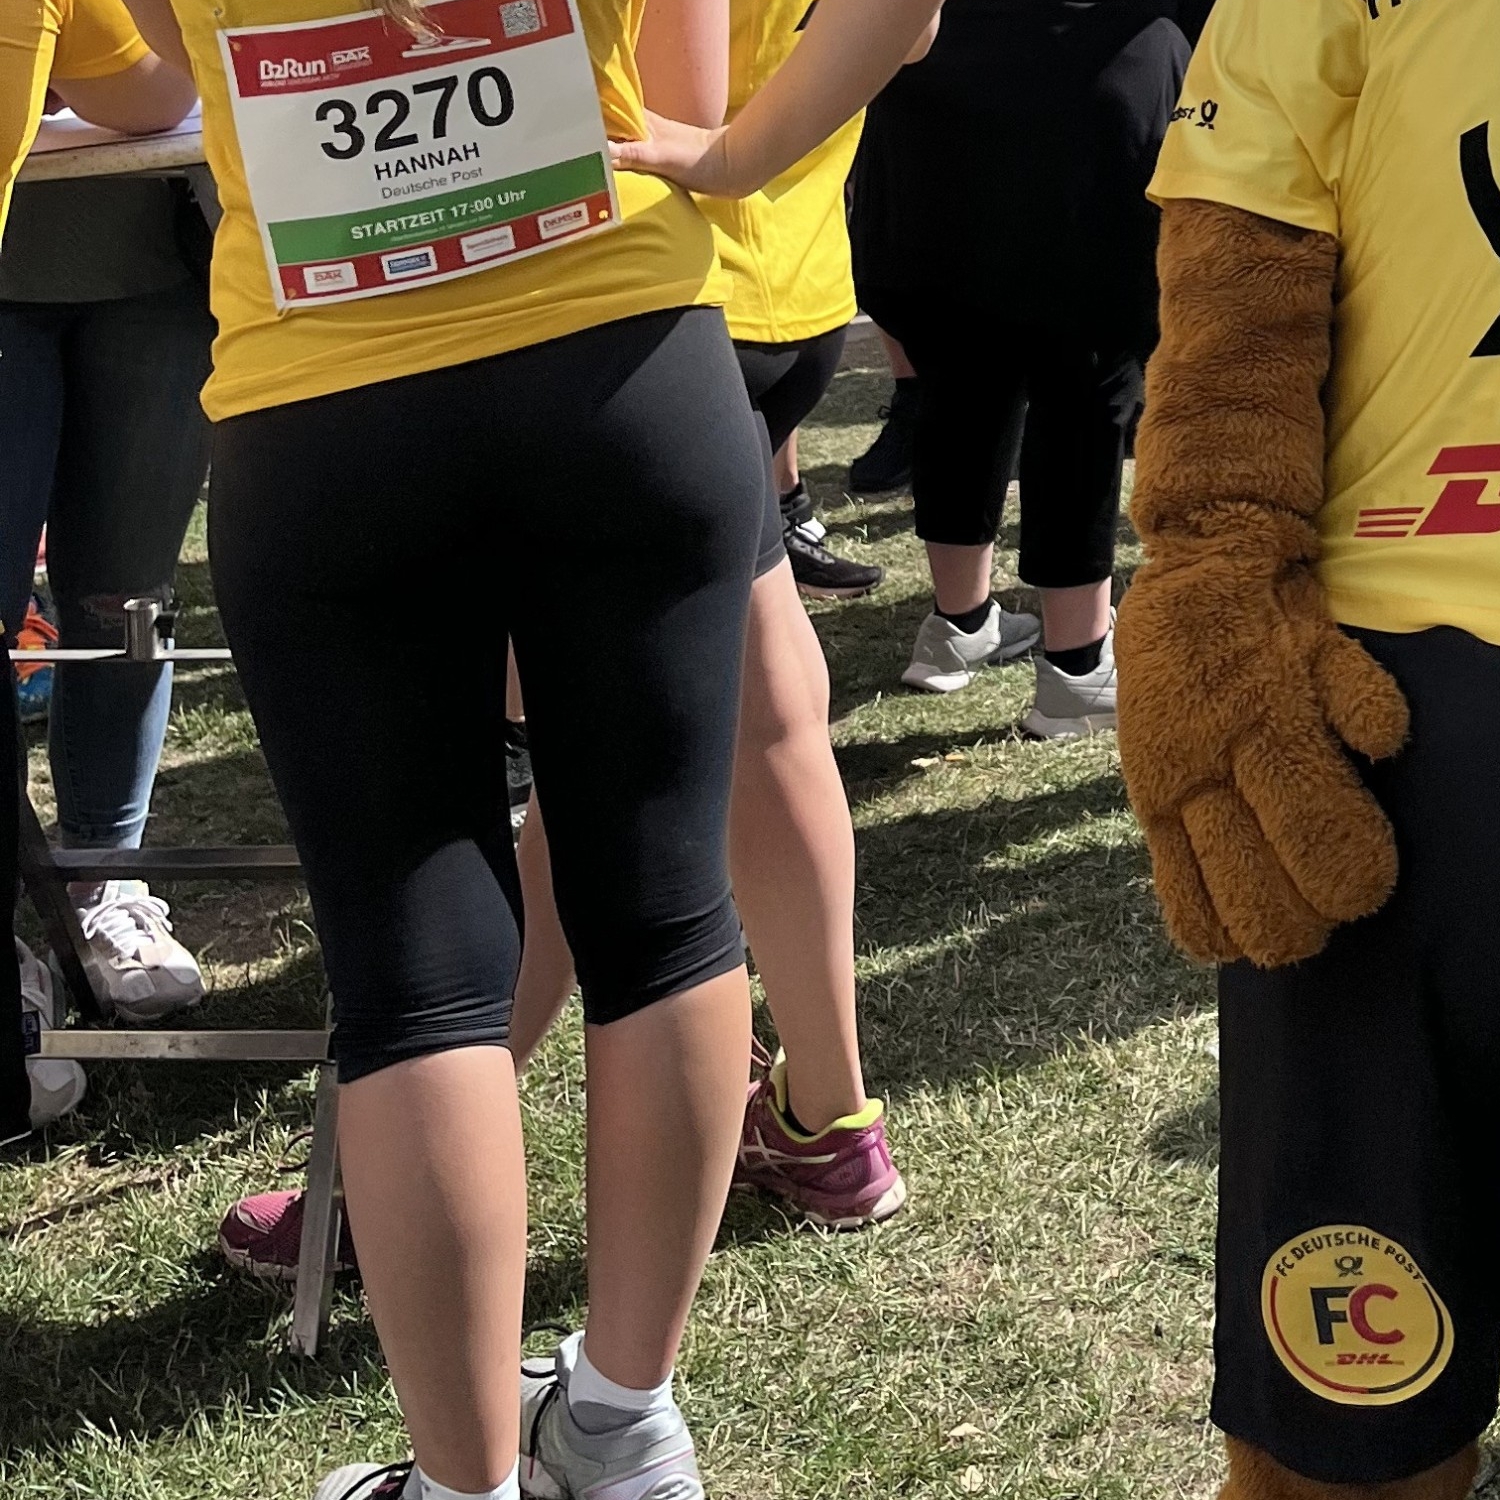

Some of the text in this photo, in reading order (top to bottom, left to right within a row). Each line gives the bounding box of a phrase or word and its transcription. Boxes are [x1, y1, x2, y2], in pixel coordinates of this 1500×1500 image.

[259, 59, 327, 80] B2Run
[330, 46, 371, 64] DAK
[315, 66, 515, 160] 3270
[374, 142, 480, 180] HANNAH
[381, 167, 483, 199] Deutsche Post
[351, 207, 445, 240] STARTZEIT
[451, 197, 494, 218] 17:00
[497, 190, 527, 206] Uhr
[1275, 1231, 1424, 1281] FC DEUTSCHE POST
[1310, 1283, 1406, 1345] FC
[1336, 1353, 1394, 1365] DHL
